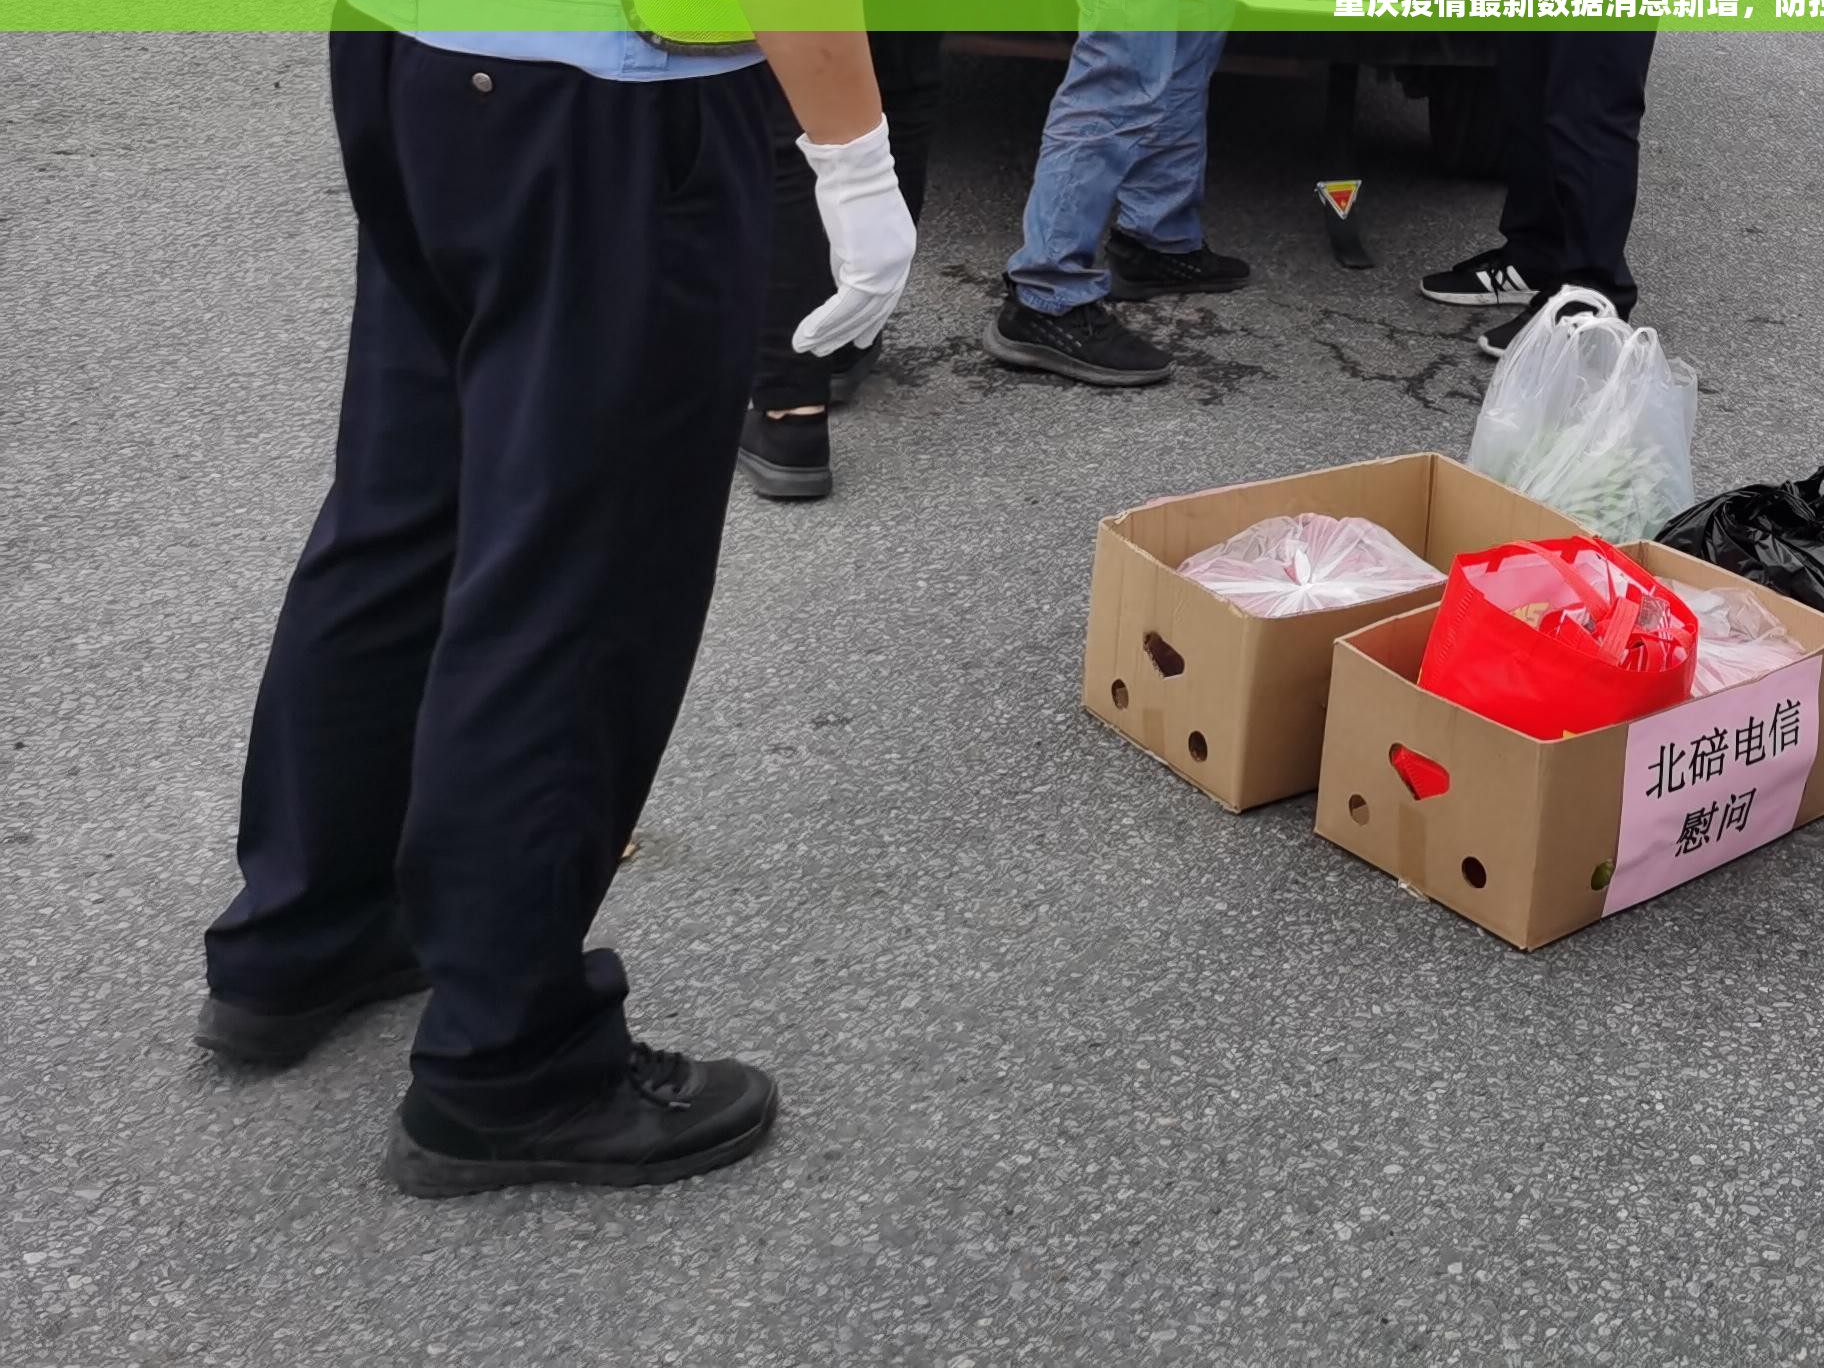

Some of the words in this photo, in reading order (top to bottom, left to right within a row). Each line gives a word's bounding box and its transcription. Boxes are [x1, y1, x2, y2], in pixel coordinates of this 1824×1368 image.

[1645, 698, 1801, 800] 北碚电信
[1674, 787, 1757, 858] 慰问
